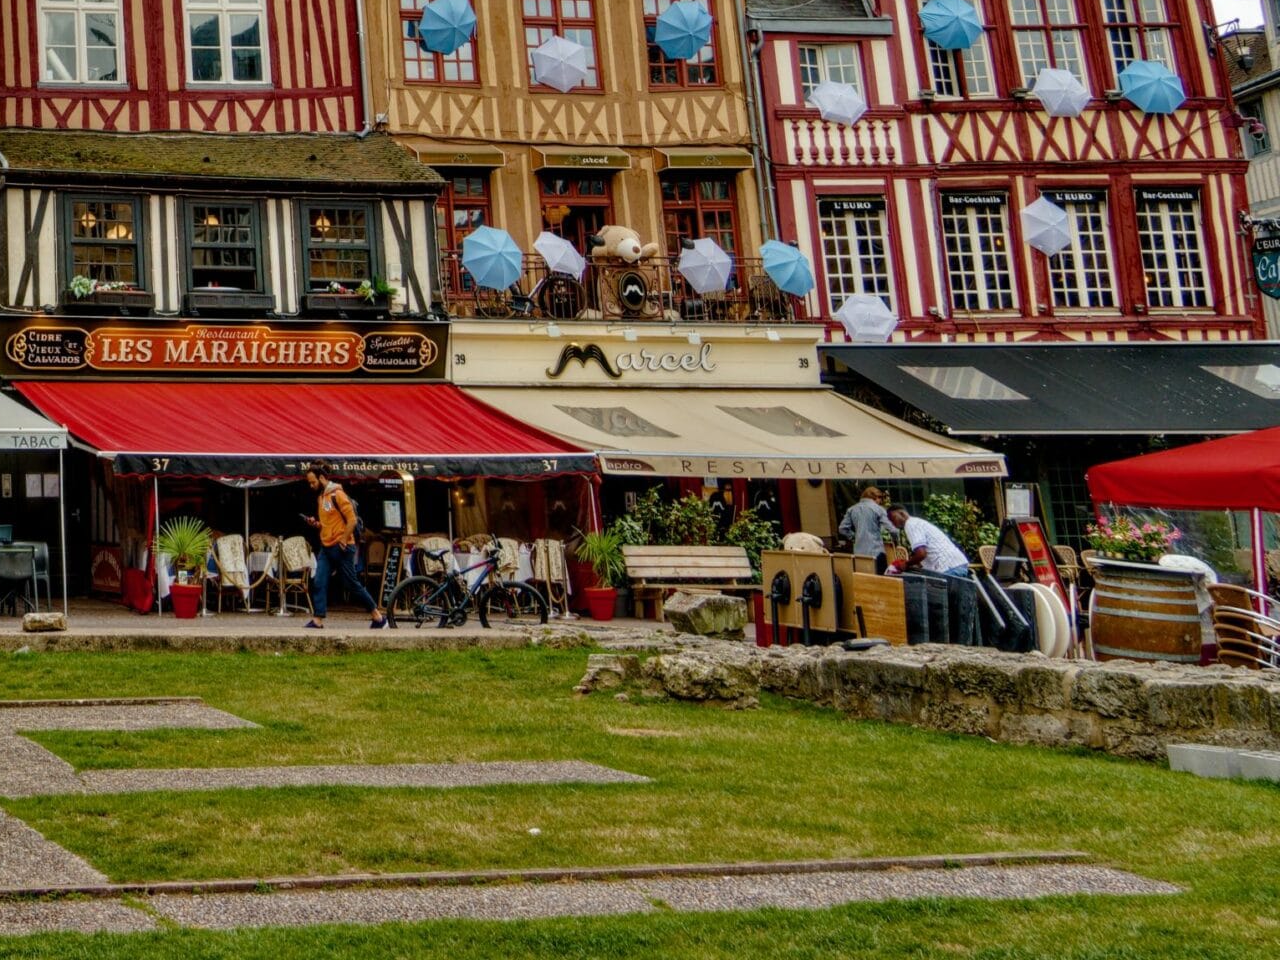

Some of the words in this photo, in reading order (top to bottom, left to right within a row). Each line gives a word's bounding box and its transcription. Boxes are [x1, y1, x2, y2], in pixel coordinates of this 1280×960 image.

[948, 195, 1001, 204] Bar-Cocktails
[1055, 192, 1093, 201] L'EURO
[1142, 191, 1194, 200] Bar-Cocktails
[834, 201, 872, 210] L'EURO
[29, 331, 63, 342] CIDRE
[195, 327, 261, 340] Restaurant
[28, 343, 61, 354] VIEUX
[101, 338, 153, 363] LES
[163, 339, 351, 365] MARAICHERS
[28, 353, 81, 364] CALVADOS
[366, 355, 418, 366] BEAUJOLAIS
[454, 353, 466, 365] 39
[797, 357, 810, 369] 39
[11, 435, 60, 448] TABAC
[152, 458, 170, 471] 37
[381, 463, 394, 471] en
[397, 462, 419, 471] 1912
[541, 459, 558, 472] 37
[607, 461, 642, 472] apéro
[681, 459, 928, 475] RESTAURANT
[964, 463, 999, 473] bistro
